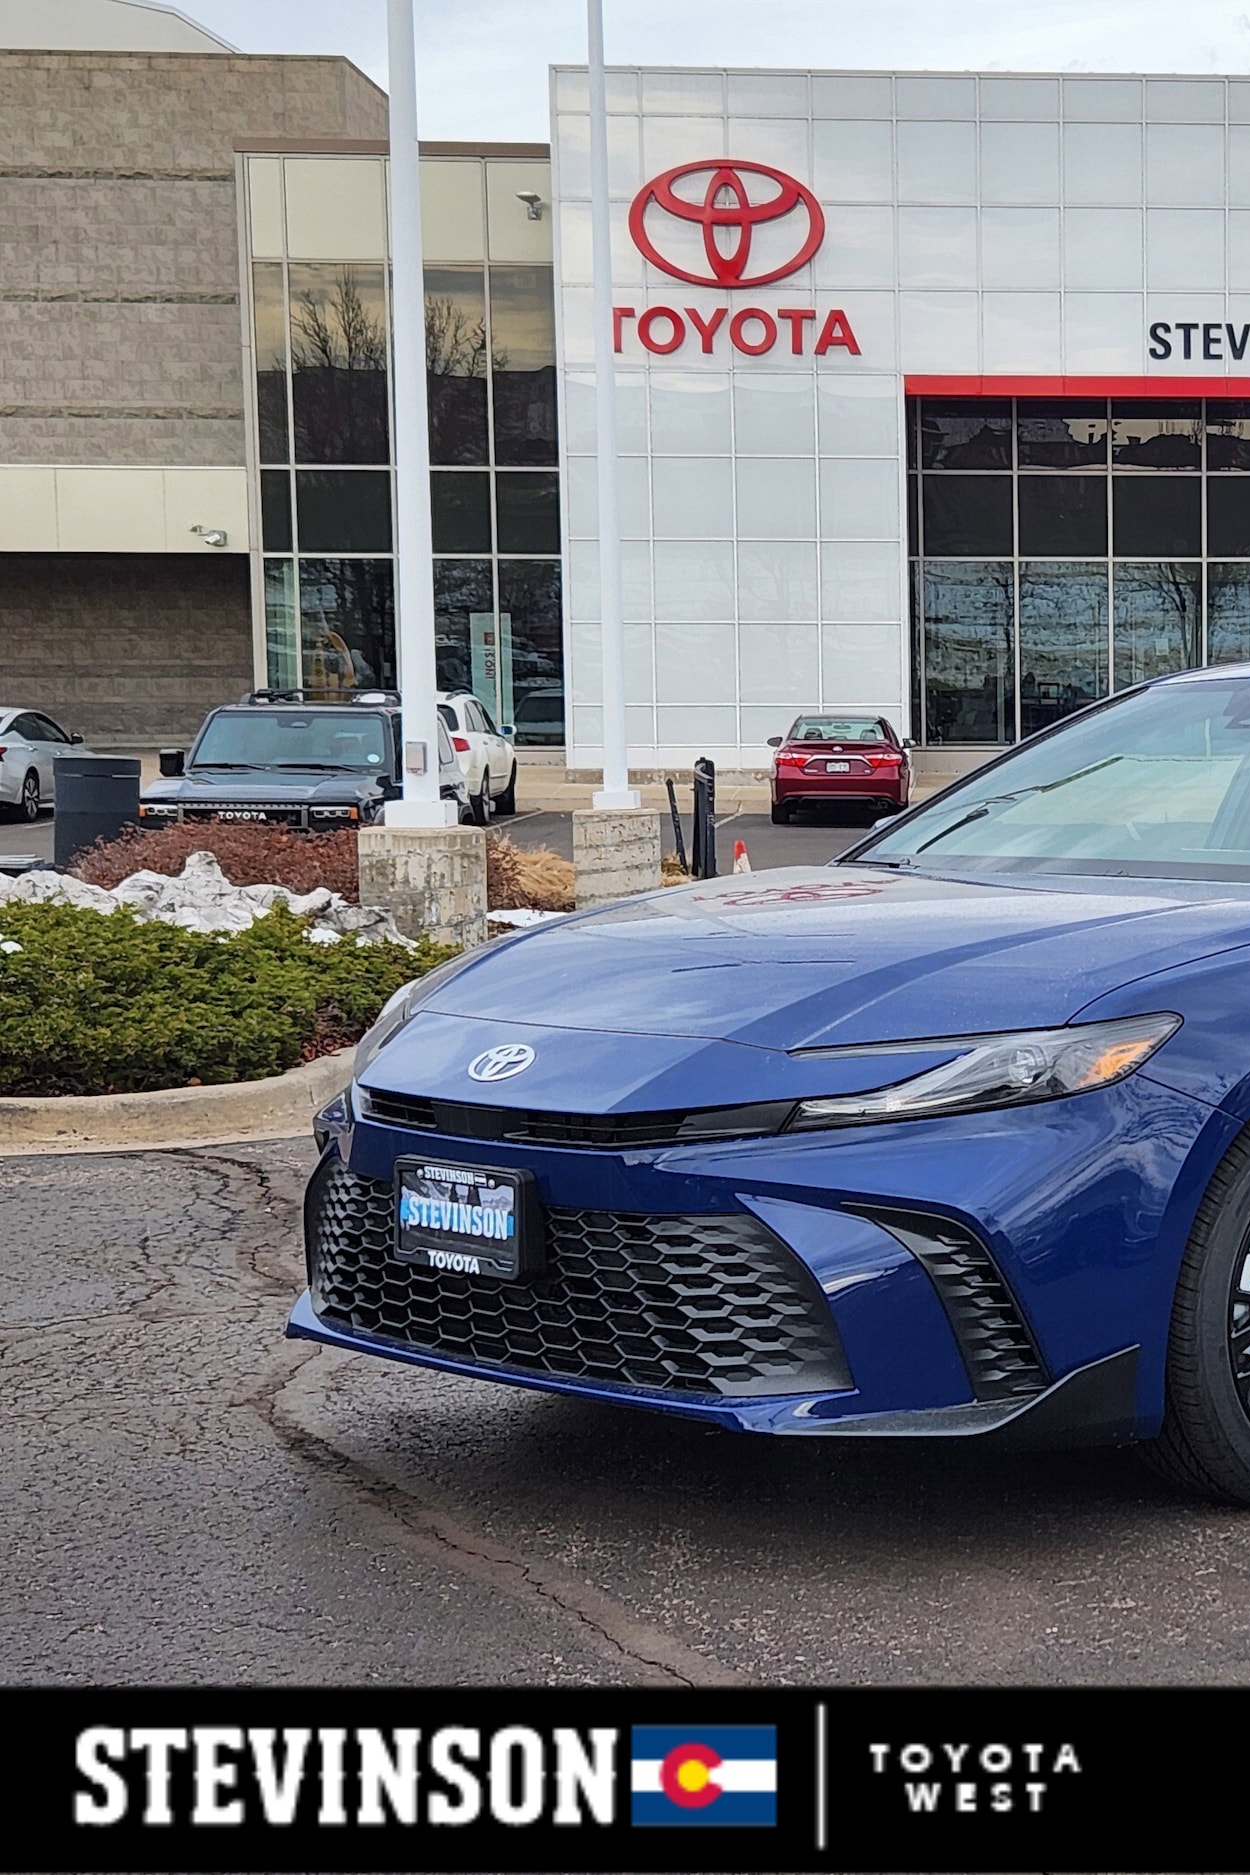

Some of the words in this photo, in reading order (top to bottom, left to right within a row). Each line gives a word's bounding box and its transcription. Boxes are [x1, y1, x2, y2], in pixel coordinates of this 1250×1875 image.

[612, 306, 861, 355] TOYOTA
[218, 811, 267, 821] TOYOTA
[423, 1166, 475, 1186] STEVINSON
[408, 1197, 509, 1241] STEVINSON
[427, 1251, 481, 1275] TOYOTA
